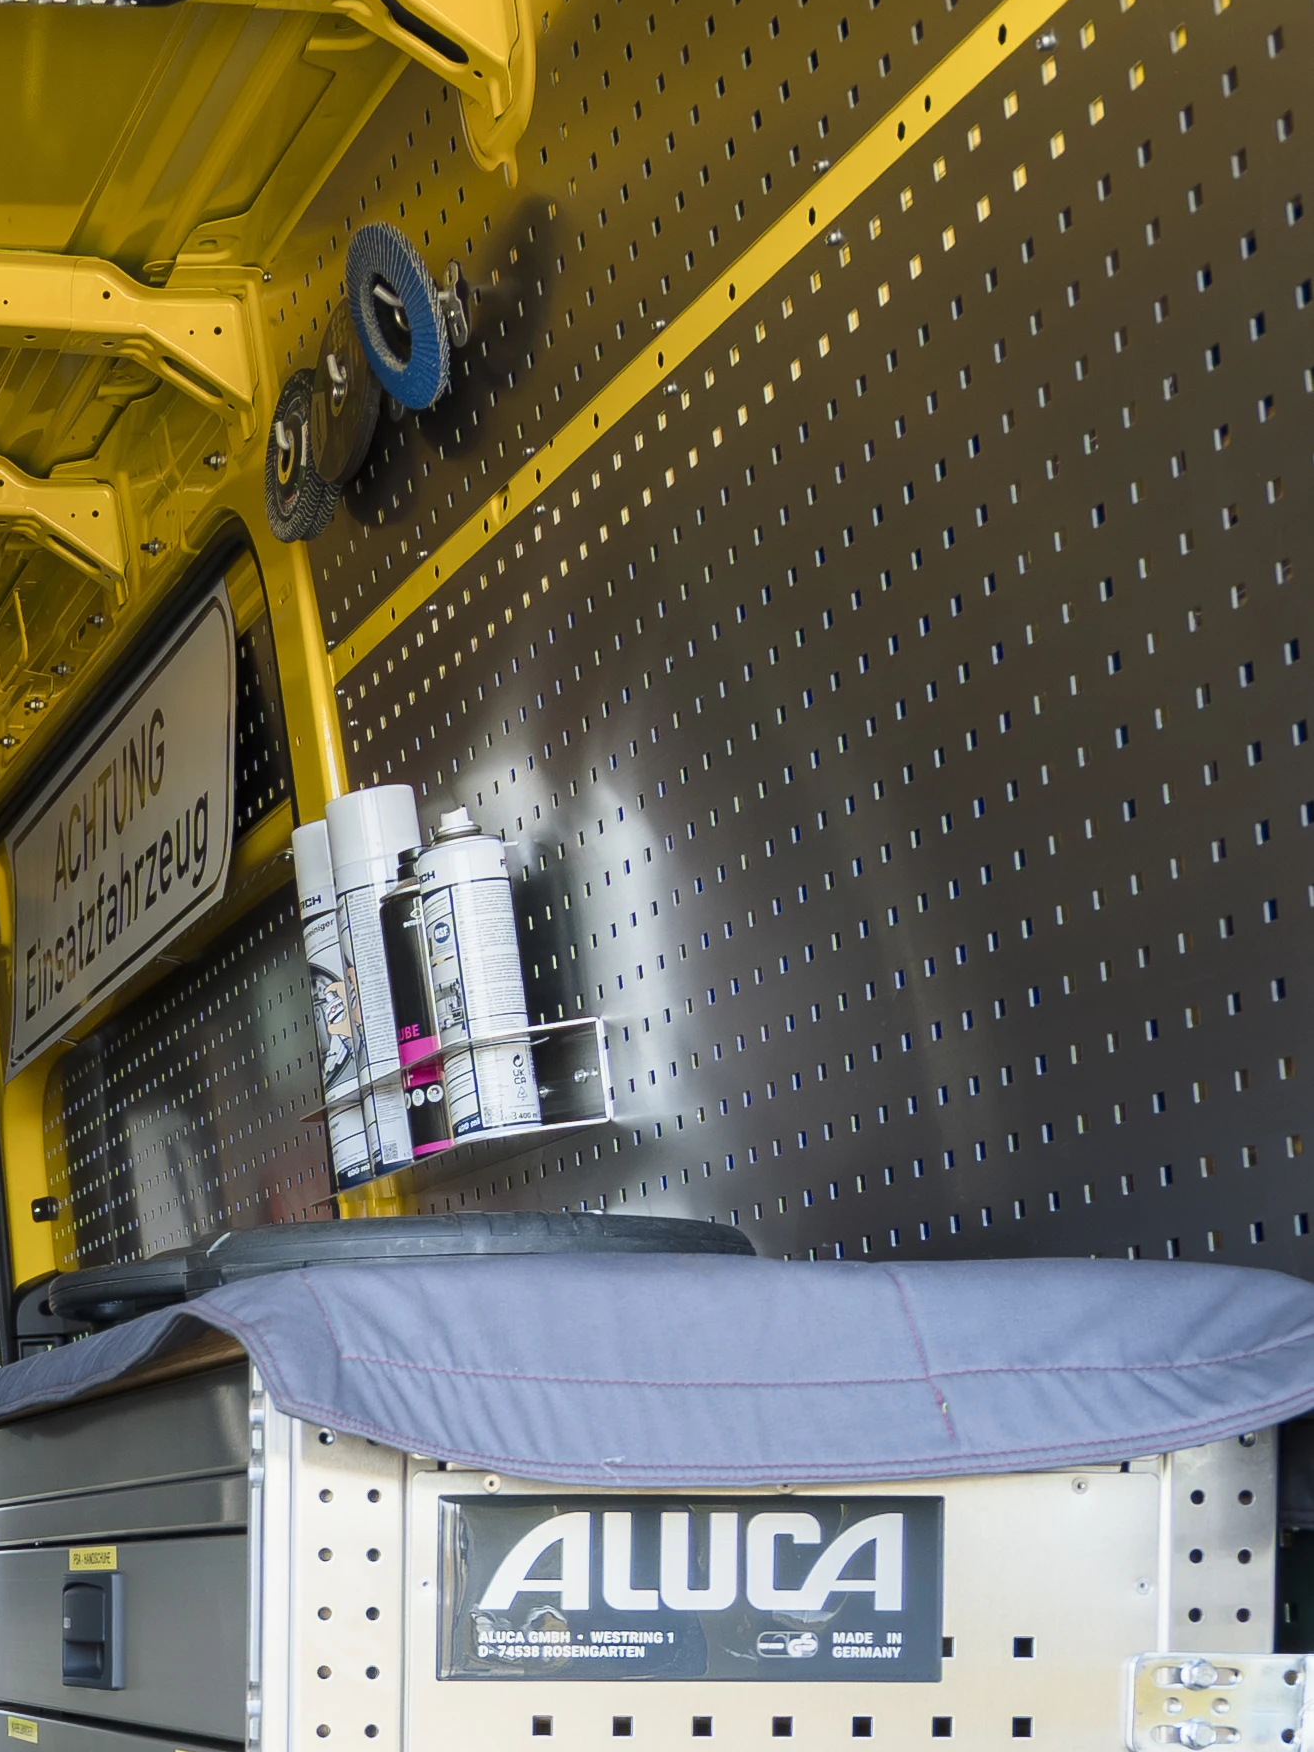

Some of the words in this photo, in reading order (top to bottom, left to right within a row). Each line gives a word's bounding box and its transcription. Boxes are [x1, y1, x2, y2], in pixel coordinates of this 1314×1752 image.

[53, 708, 165, 902] ACHTUNG
[25, 791, 209, 1023] Einsatzfahrzeug
[399, 1023, 421, 1041] UBE
[477, 1511, 904, 1612] ALUCA
[477, 1631, 525, 1644] ALUCA
[527, 1631, 571, 1644] GMBH
[590, 1631, 664, 1644] WESTRING
[666, 1631, 675, 1644] 1
[832, 1631, 874, 1645] MADE
[886, 1631, 903, 1645] IN
[477, 1645, 494, 1658] D-
[542, 1645, 646, 1658] ROSENGARTEN
[831, 1646, 902, 1659] GERMANY
